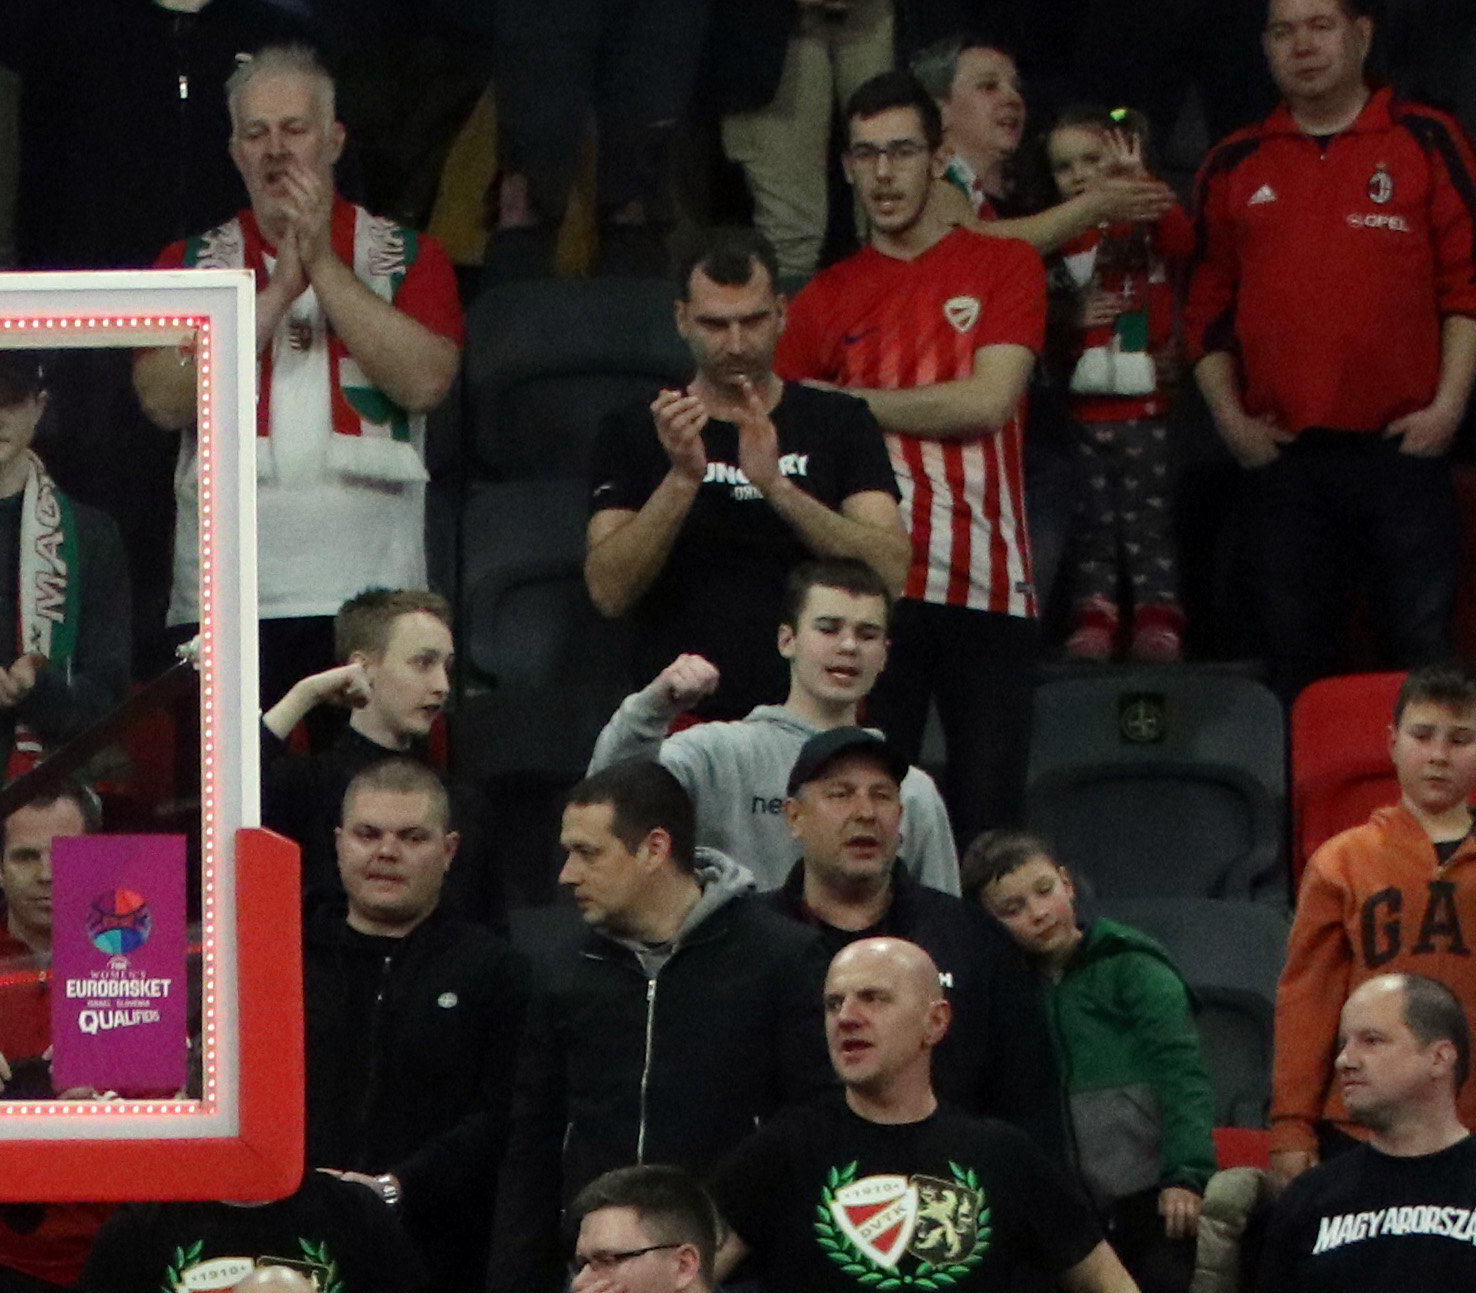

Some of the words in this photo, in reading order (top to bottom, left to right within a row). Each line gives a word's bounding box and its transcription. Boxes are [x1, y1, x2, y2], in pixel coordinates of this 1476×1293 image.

[1365, 215, 1409, 233] OPEL
[65, 978, 172, 999] EUROBASKET
[78, 1009, 161, 1036] QUALIFIERS
[860, 1203, 907, 1241] DVTK
